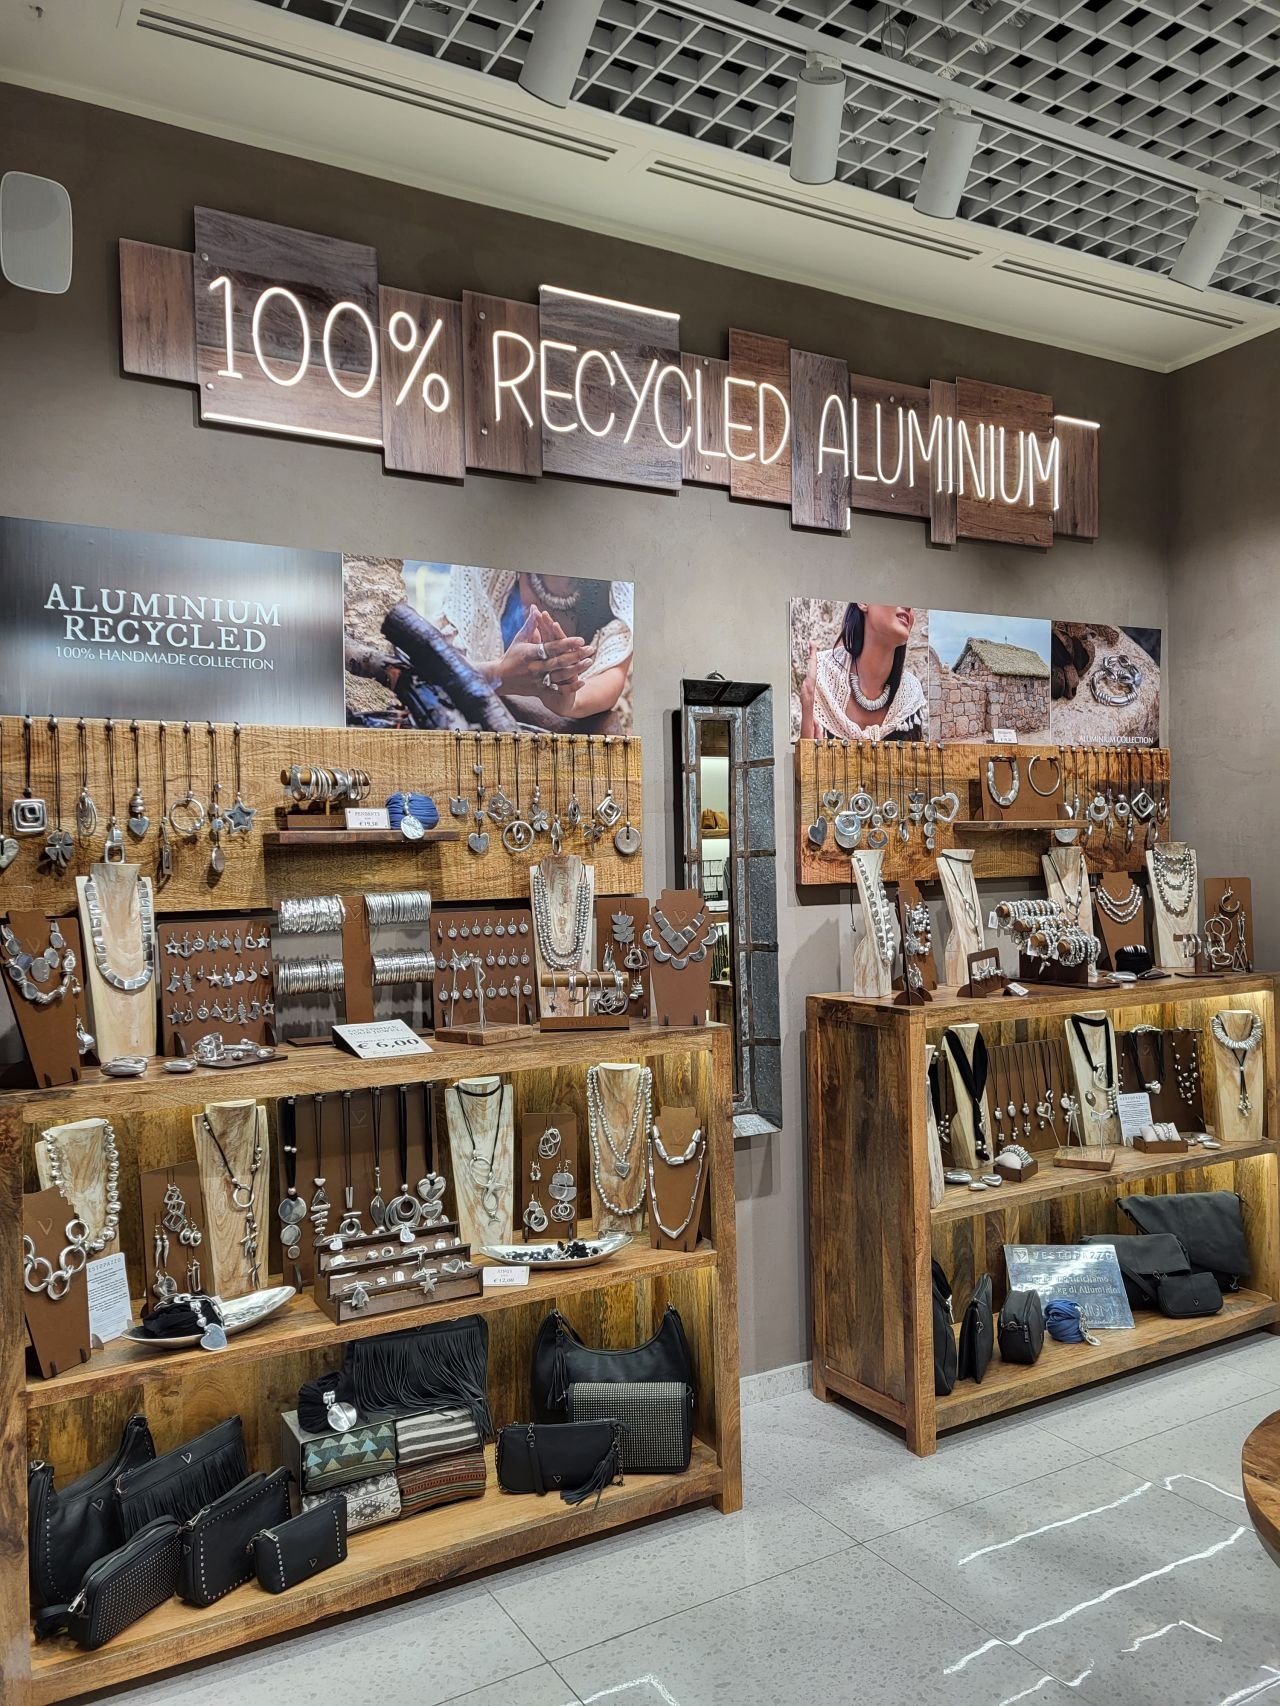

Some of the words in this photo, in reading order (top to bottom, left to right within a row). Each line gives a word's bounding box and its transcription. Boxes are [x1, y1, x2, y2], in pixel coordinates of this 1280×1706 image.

[208, 276, 450, 413] 100%
[492, 330, 791, 465] RECYCLED
[817, 394, 1060, 511] ALUMINIUM
[43, 582, 281, 627] ALUMINIUM
[63, 614, 267, 653] RECYCLED
[55, 646, 95, 660] 100%
[99, 649, 187, 665] HANDMADE
[189, 654, 275, 671] COLLECTION
[1078, 735, 1116, 744] ALUMINIUM
[1116, 736, 1154, 744] COLLECTION
[376, 1038, 419, 1048] 6,00
